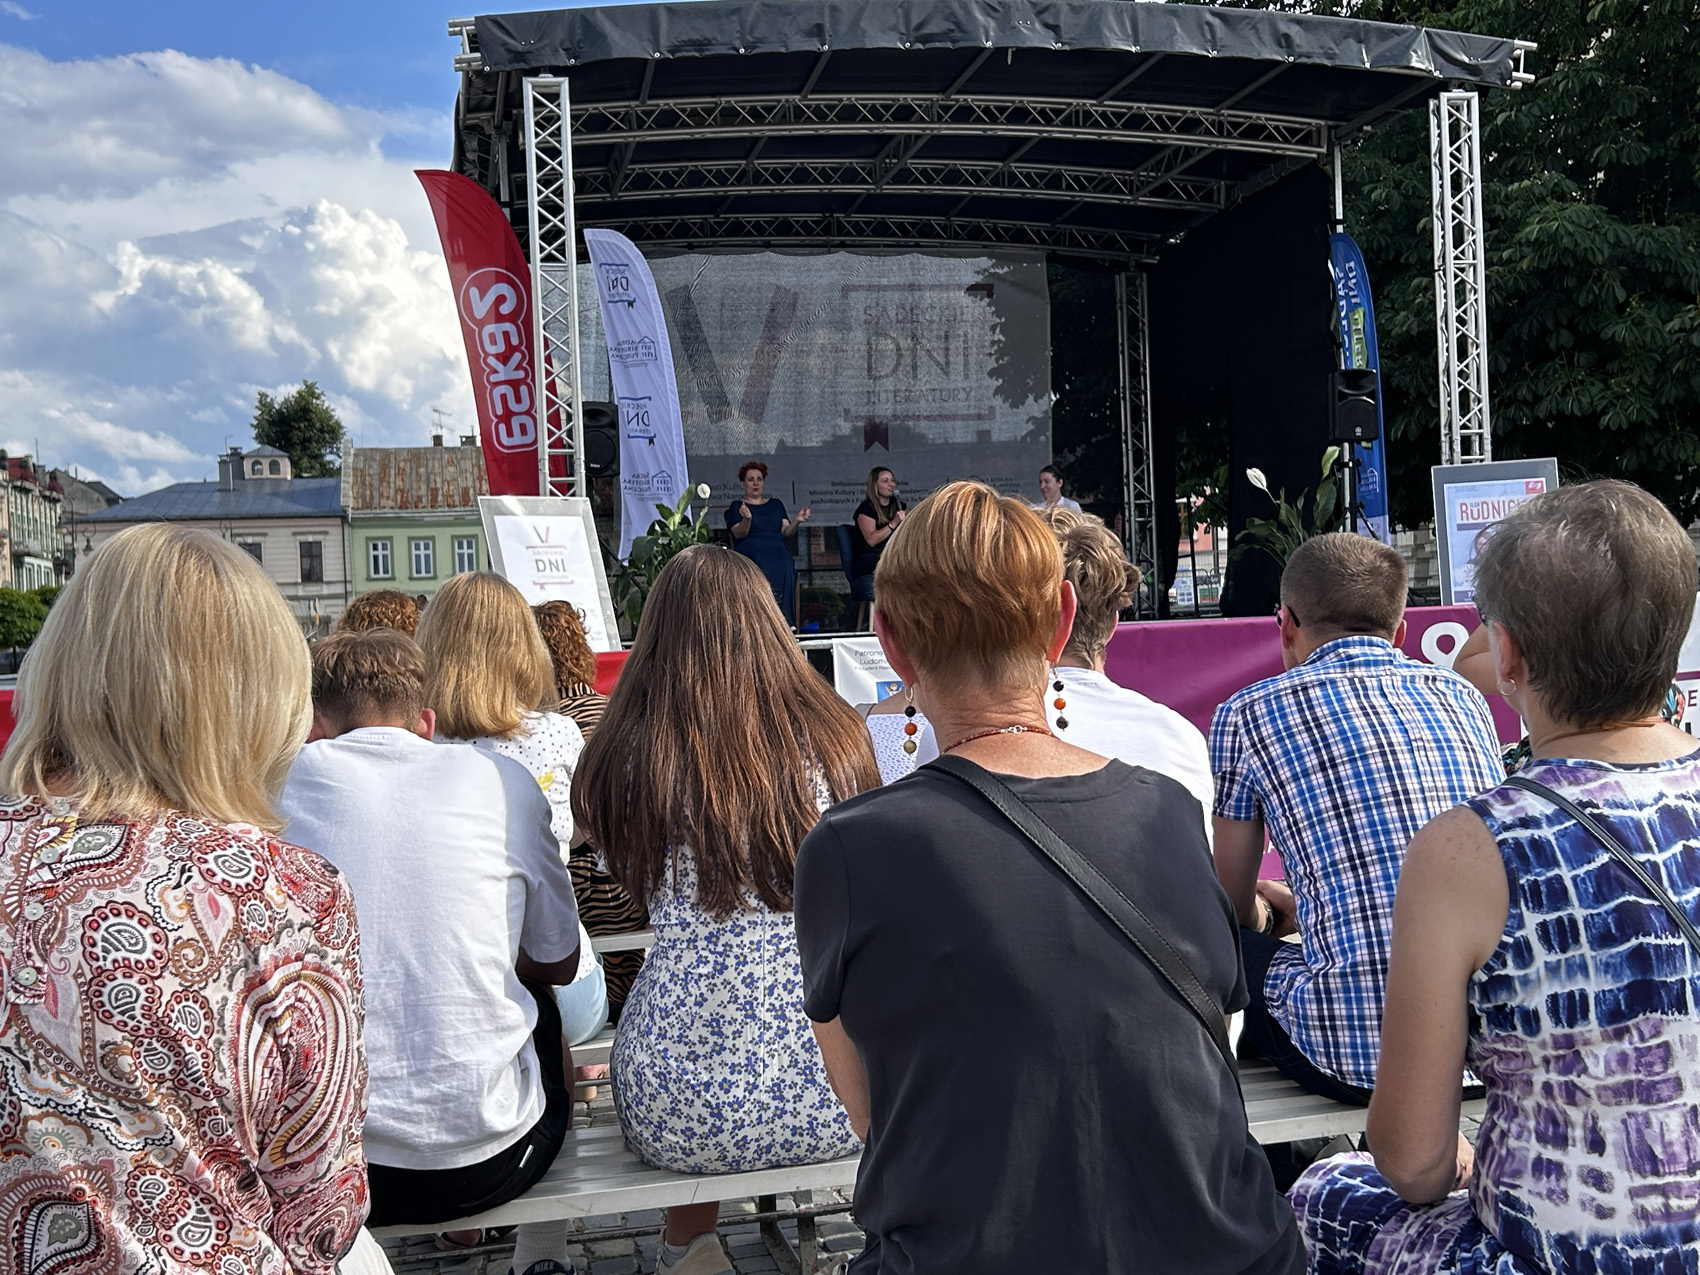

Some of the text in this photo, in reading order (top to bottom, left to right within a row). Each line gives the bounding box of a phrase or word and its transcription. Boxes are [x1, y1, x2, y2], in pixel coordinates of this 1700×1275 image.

[867, 329, 970, 382] DNI
[535, 558, 567, 573] DNI
[534, 1261, 555, 1274] NIKE
